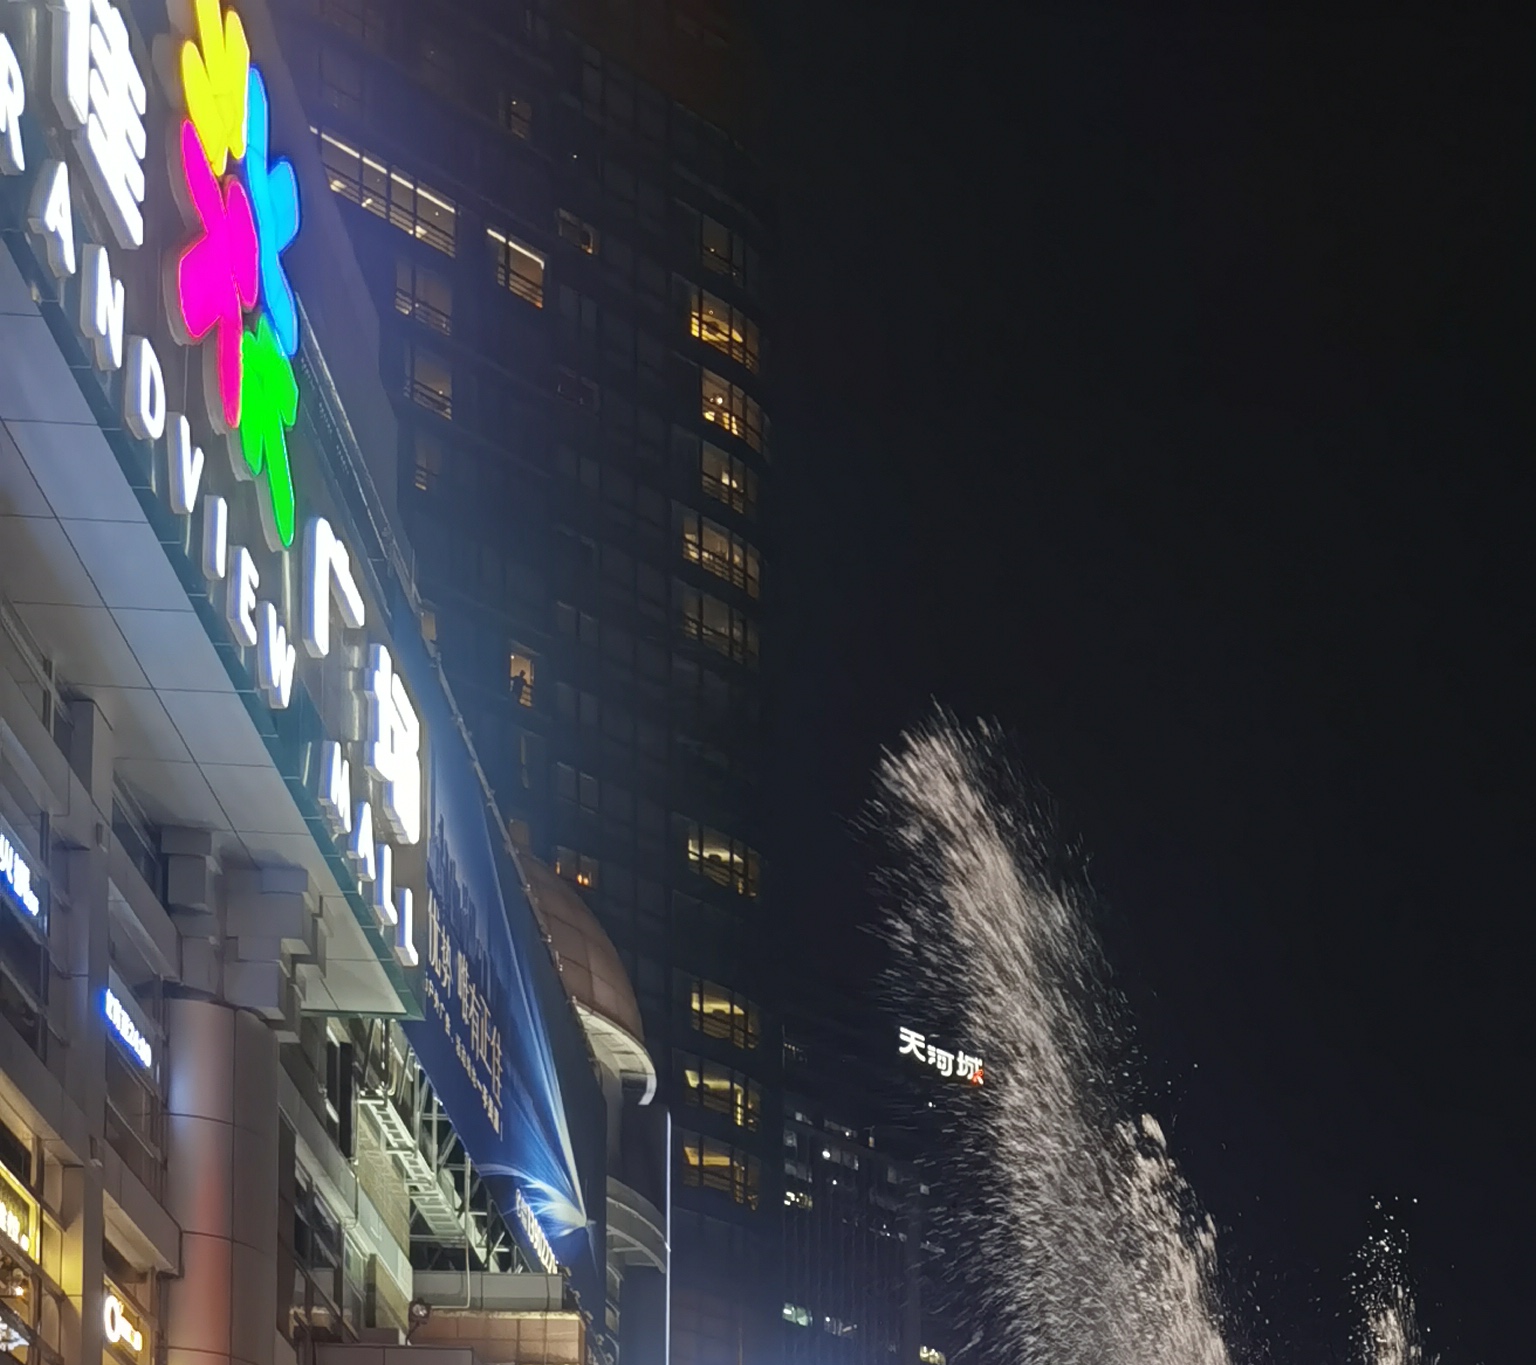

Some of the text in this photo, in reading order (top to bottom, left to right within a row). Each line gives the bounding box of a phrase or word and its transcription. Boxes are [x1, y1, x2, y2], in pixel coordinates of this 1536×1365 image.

[303, 517, 421, 846] 广场
[320, 741, 418, 967] MALL
[898, 1026, 984, 1085] 天河城
